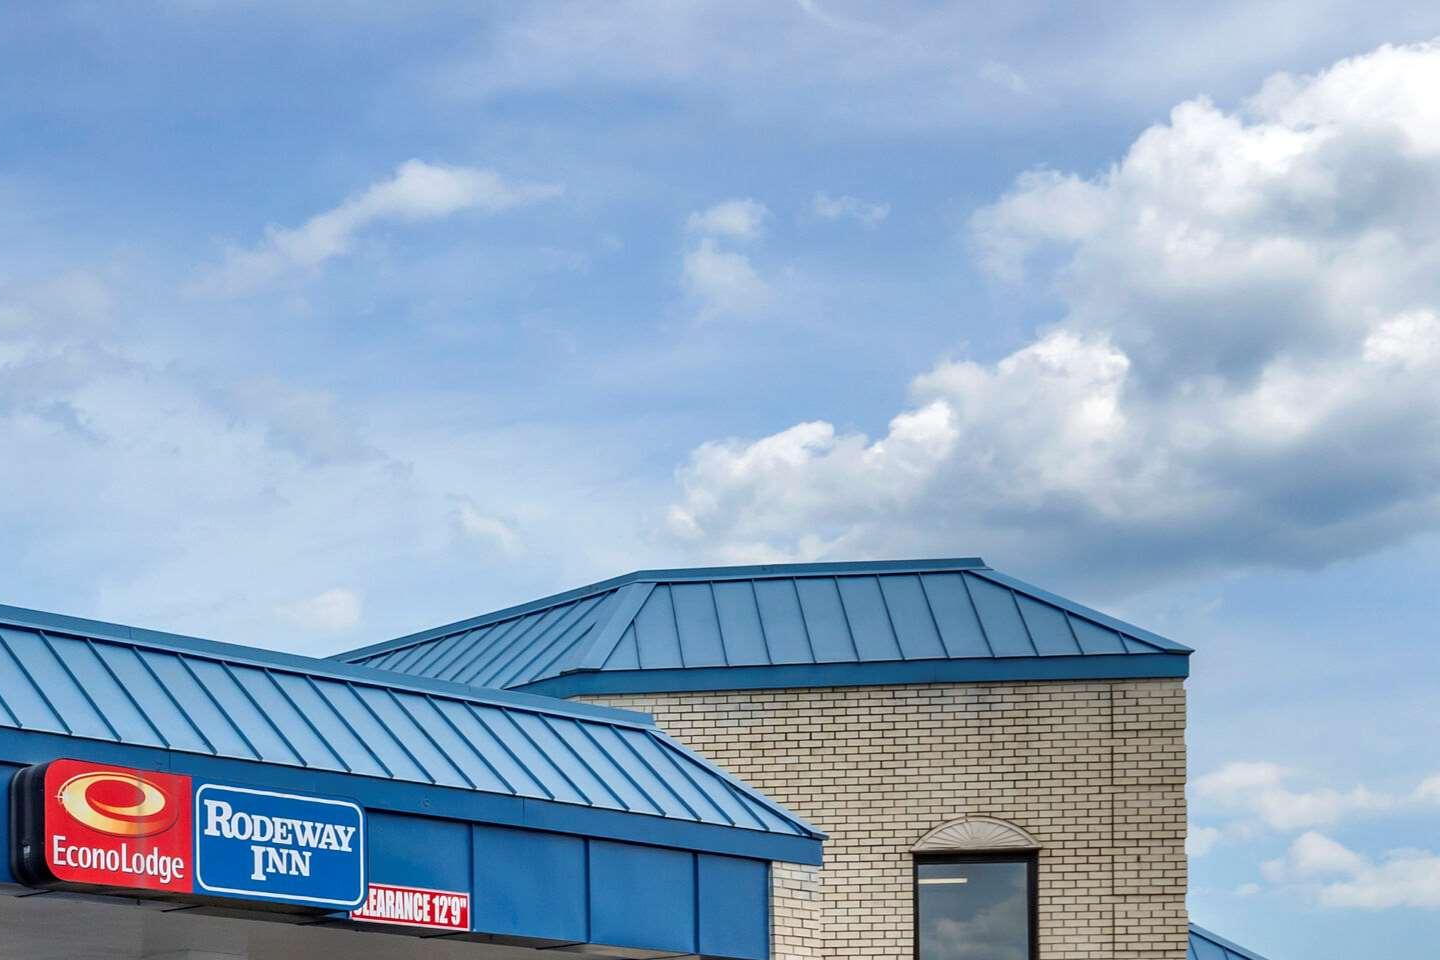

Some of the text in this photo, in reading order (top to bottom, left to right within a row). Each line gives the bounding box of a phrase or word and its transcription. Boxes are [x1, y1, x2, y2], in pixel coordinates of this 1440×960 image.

[204, 799, 356, 852] RODEWAY
[53, 834, 185, 884] EconoLodge
[251, 845, 312, 881] INN
[353, 887, 467, 926] LEARANCE 12'9"
